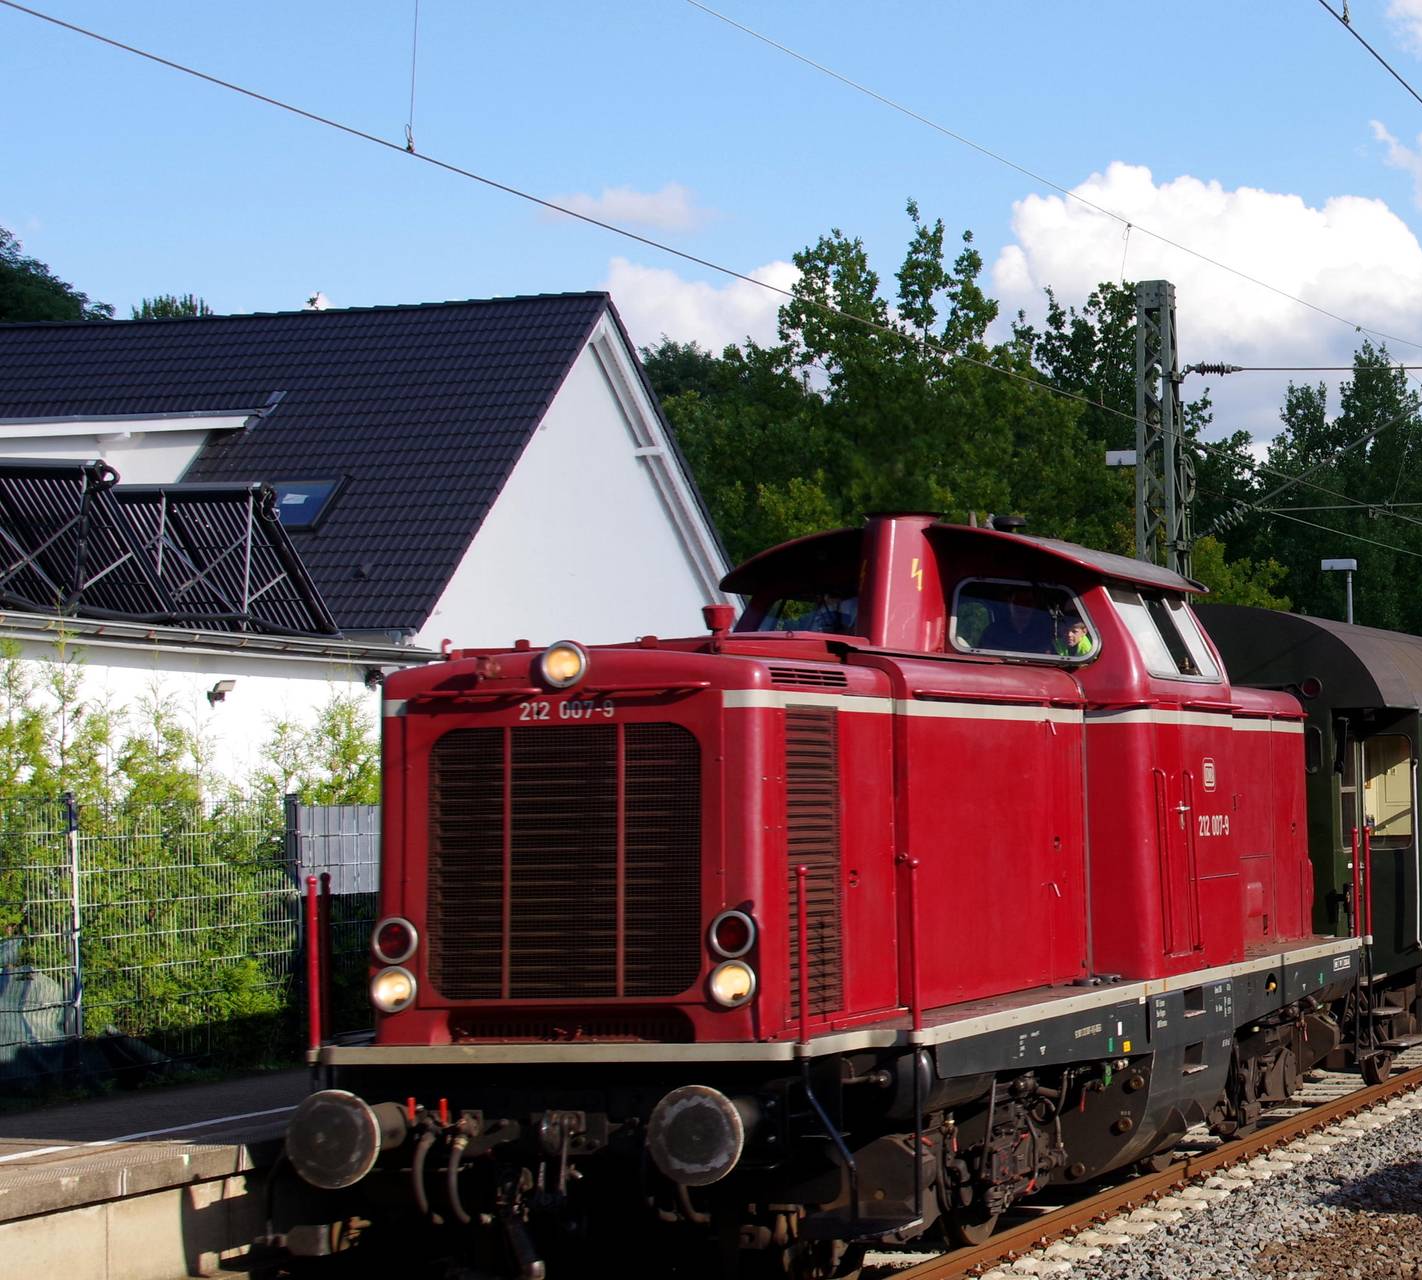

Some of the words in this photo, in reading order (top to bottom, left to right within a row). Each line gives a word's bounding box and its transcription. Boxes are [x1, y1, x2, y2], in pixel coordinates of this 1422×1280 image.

[520, 702, 550, 721] 212
[559, 700, 615, 719] 007-9
[1199, 815, 1210, 837] 212
[1212, 815, 1229, 836] 007-9
